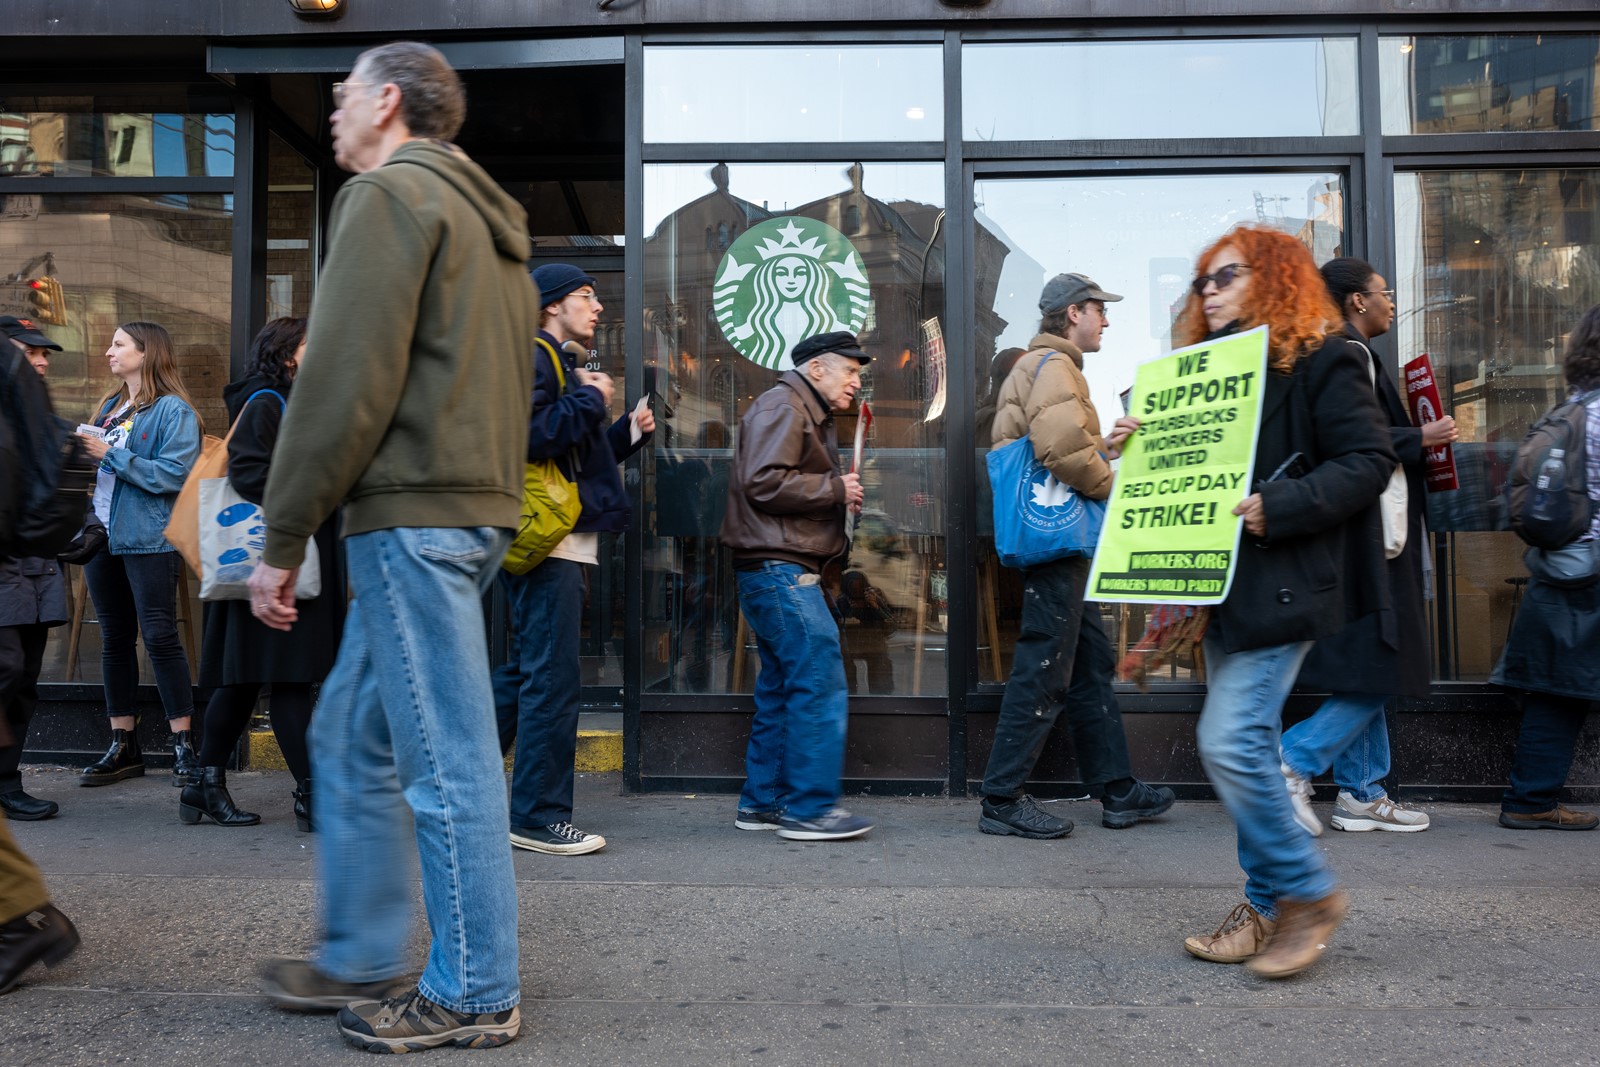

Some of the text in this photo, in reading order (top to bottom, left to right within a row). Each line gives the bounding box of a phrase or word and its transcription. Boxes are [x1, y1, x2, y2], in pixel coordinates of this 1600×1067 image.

[585, 362, 600, 371] OU
[1177, 350, 1211, 377] WE
[1144, 371, 1256, 414] SUPPORT
[1138, 407, 1238, 436] STARBUCKS
[1143, 428, 1224, 453] WORKERS
[1148, 449, 1208, 470] UNITED
[1119, 472, 1246, 499] RED CUP DAY
[1121, 501, 1219, 529] STRIKE!
[1131, 553, 1228, 569] WORKERS.ORG
[1100, 578, 1225, 592] WORKERS WORLD PARTY
